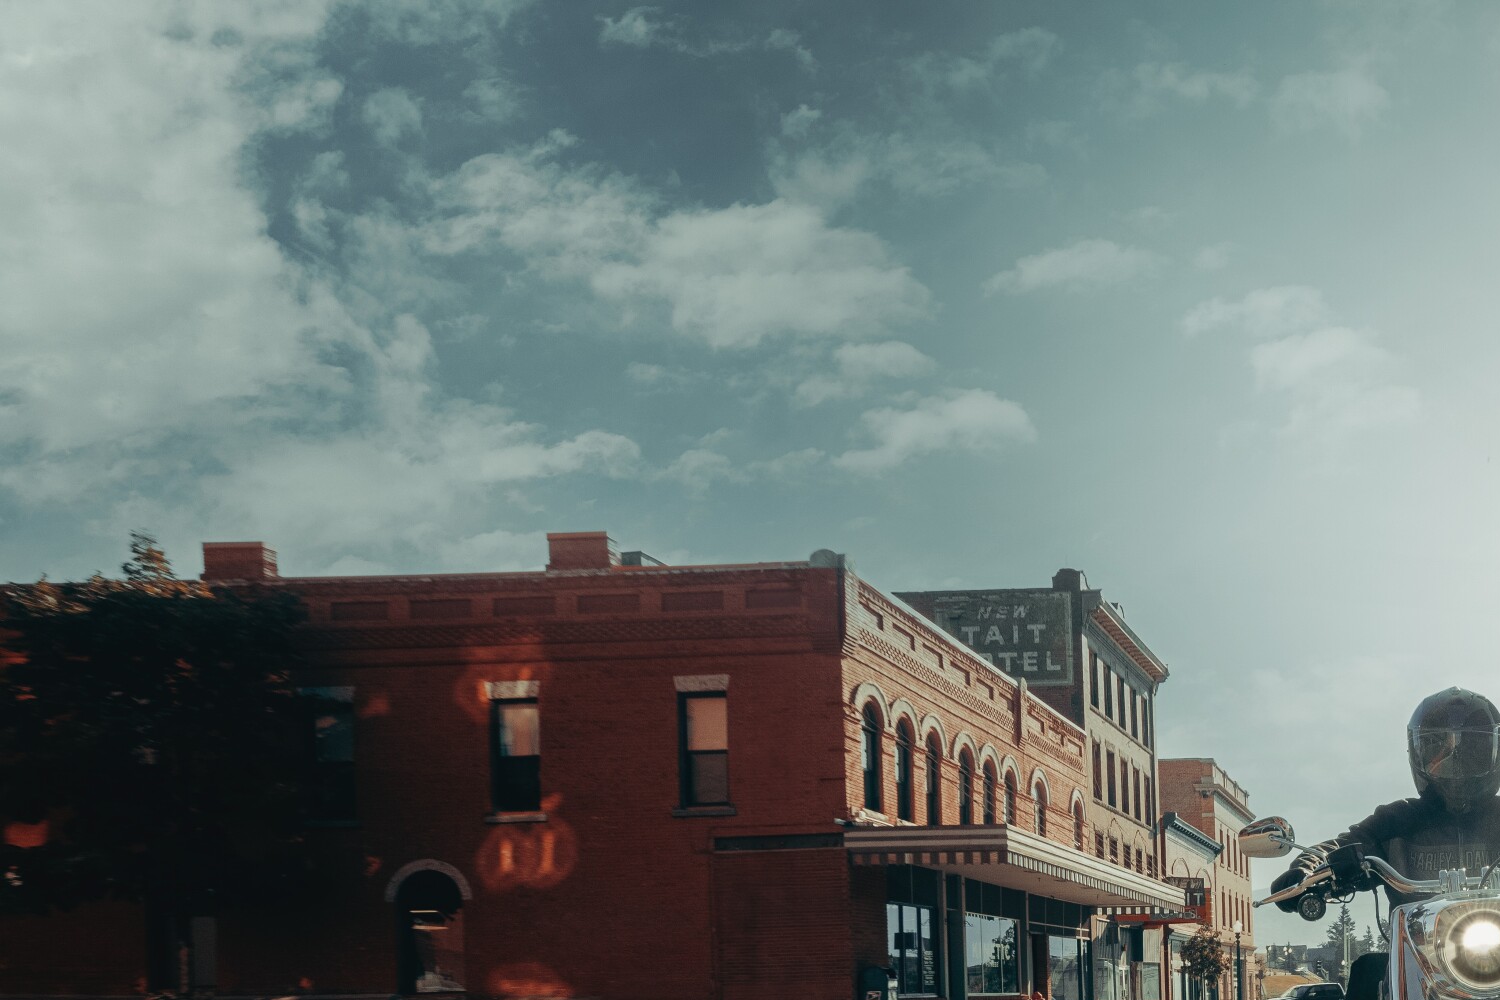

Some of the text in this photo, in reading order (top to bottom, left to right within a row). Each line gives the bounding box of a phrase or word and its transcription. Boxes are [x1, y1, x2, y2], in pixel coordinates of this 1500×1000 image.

[977, 605, 1030, 619] NEW
[961, 624, 1046, 646] TAIT
[1186, 892, 1204, 907] IT
